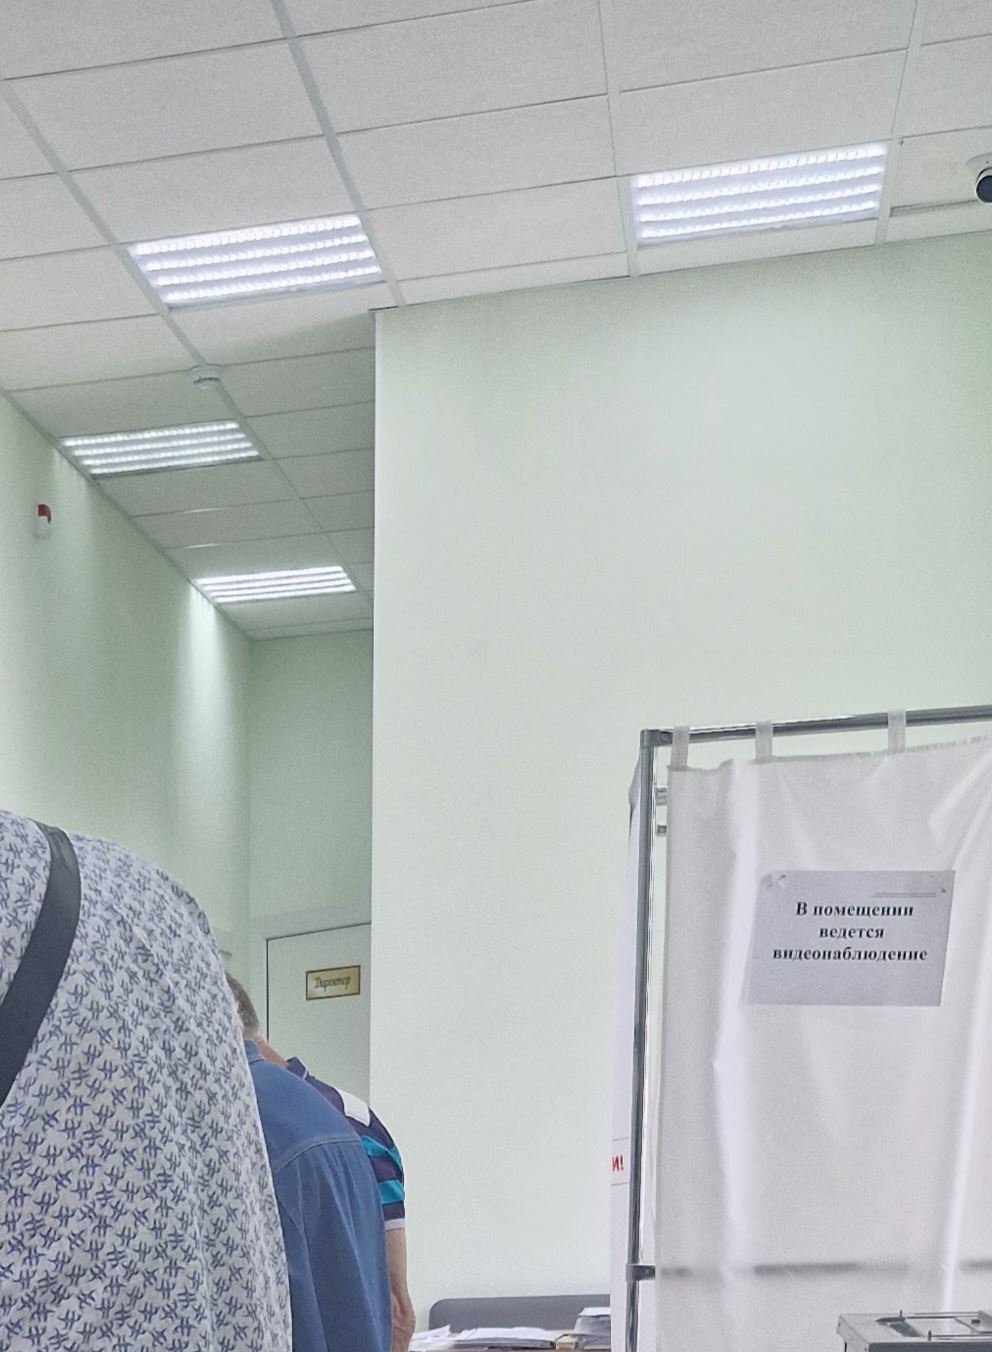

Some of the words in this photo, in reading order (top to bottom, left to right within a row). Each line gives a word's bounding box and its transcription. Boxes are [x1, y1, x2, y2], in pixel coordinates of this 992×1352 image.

[795, 901, 808, 916] В
[813, 904, 914, 918] помещении
[819, 927, 884, 940] ведется
[773, 946, 928, 963] видеонаблюдение
